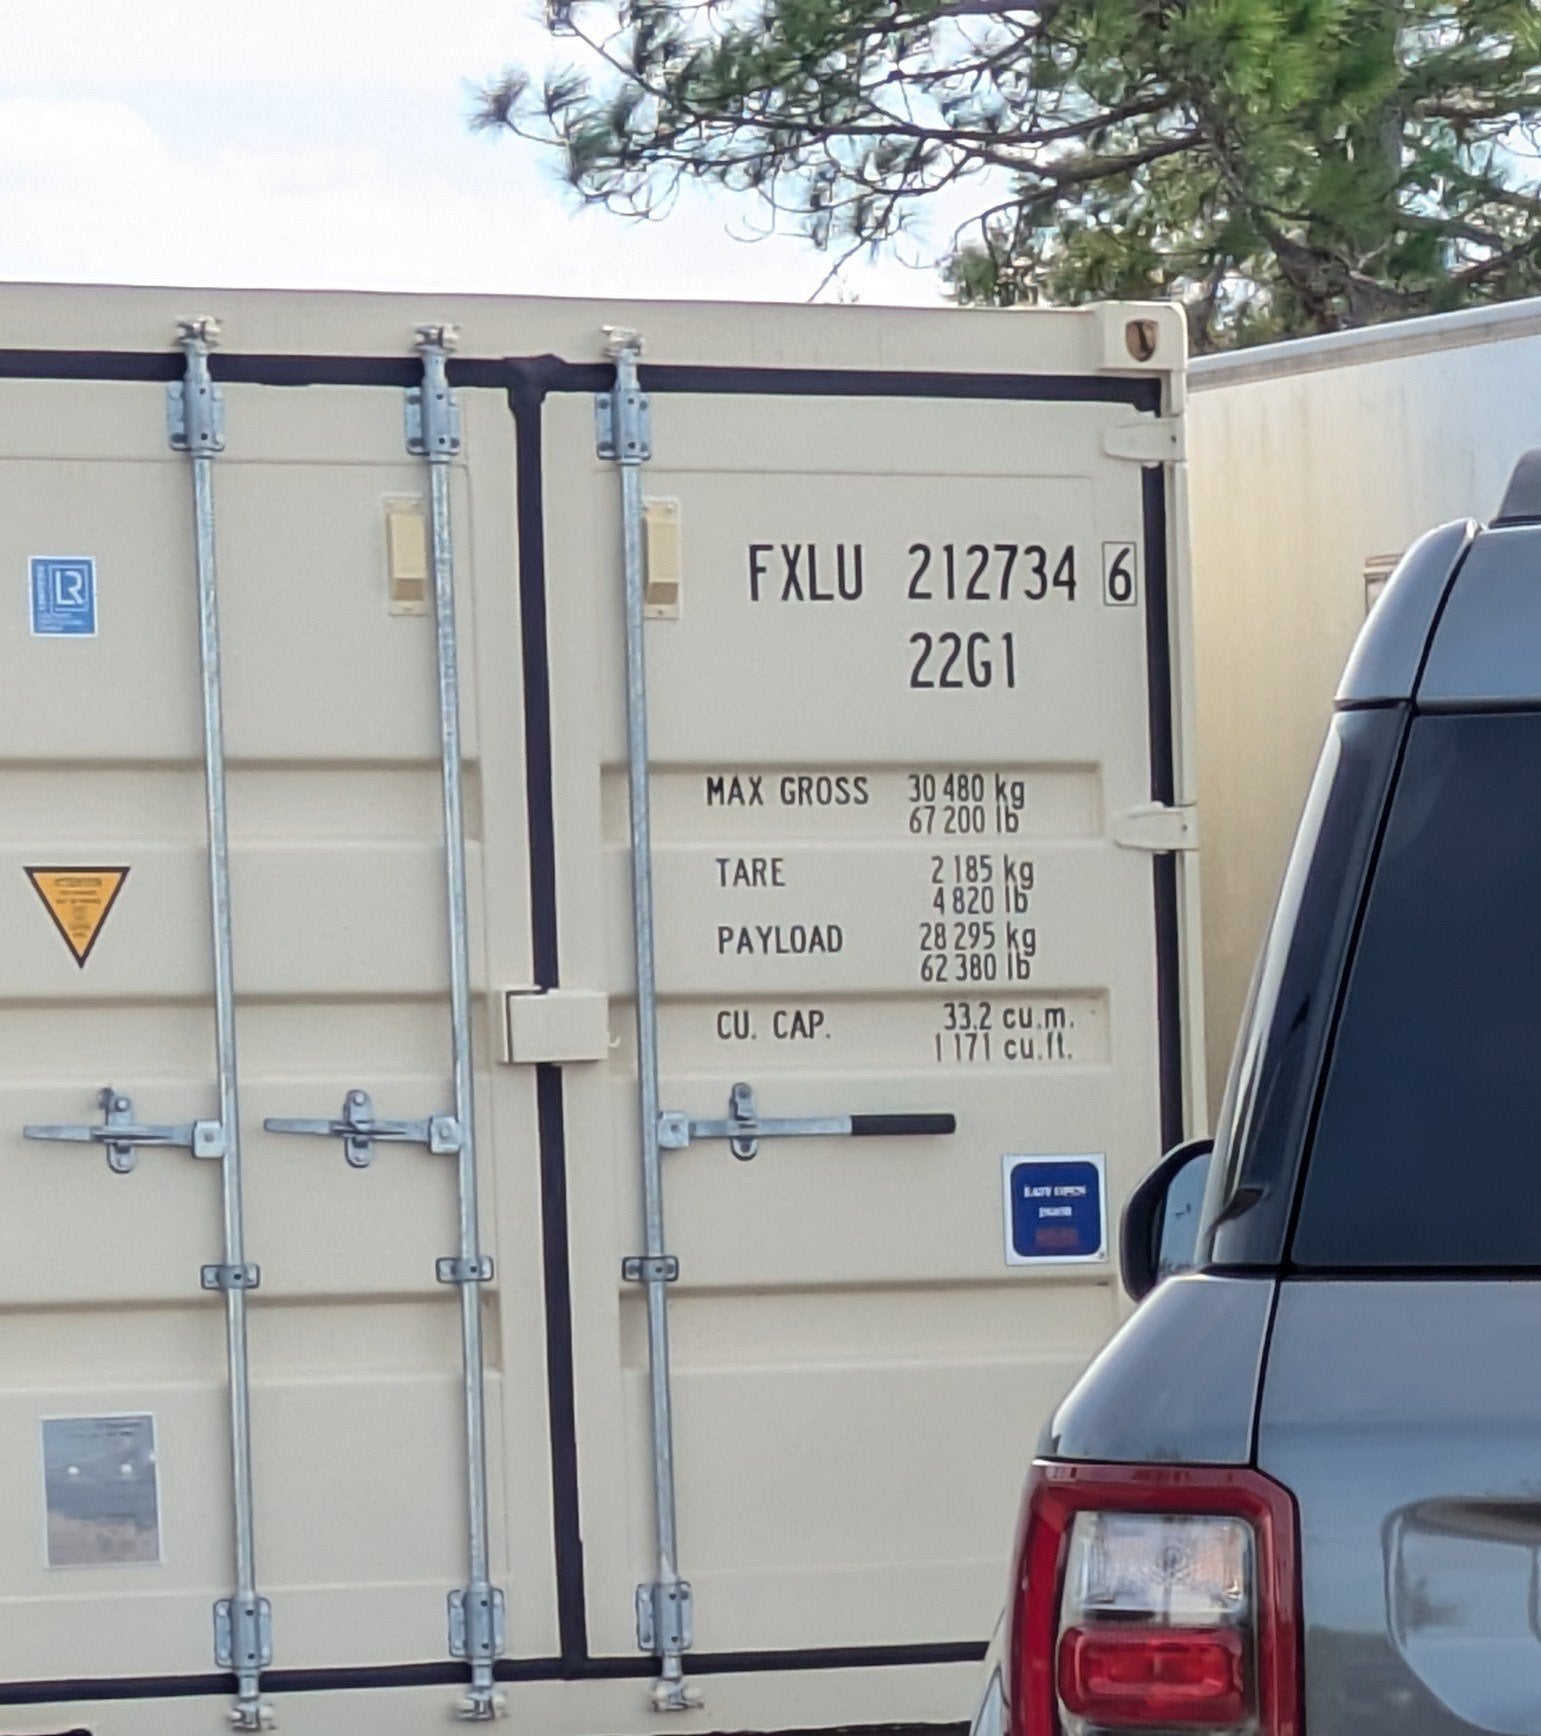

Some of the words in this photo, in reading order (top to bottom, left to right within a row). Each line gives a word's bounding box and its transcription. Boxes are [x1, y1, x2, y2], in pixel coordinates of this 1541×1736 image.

[750, 544, 862, 601] FXLU
[909, 544, 1077, 602] 212734
[1108, 546, 1132, 602] 6
[910, 632, 1014, 688] 22G1
[707, 776, 762, 805] MAX
[781, 777, 868, 805] GROSS
[996, 773, 1025, 808] kg
[997, 805, 1020, 833] lb
[716, 858, 785, 886] TARE
[1004, 855, 1034, 890] kg
[1006, 887, 1029, 914] lb
[718, 925, 842, 954] PAYLOAD
[1007, 921, 1036, 957] kg
[1008, 954, 1031, 981] lb
[717, 1010, 755, 1039] CU.
[774, 1010, 829, 1039] CAP.
[944, 1002, 992, 1031] 33.2
[1003, 1004, 1074, 1030] cu.m.
